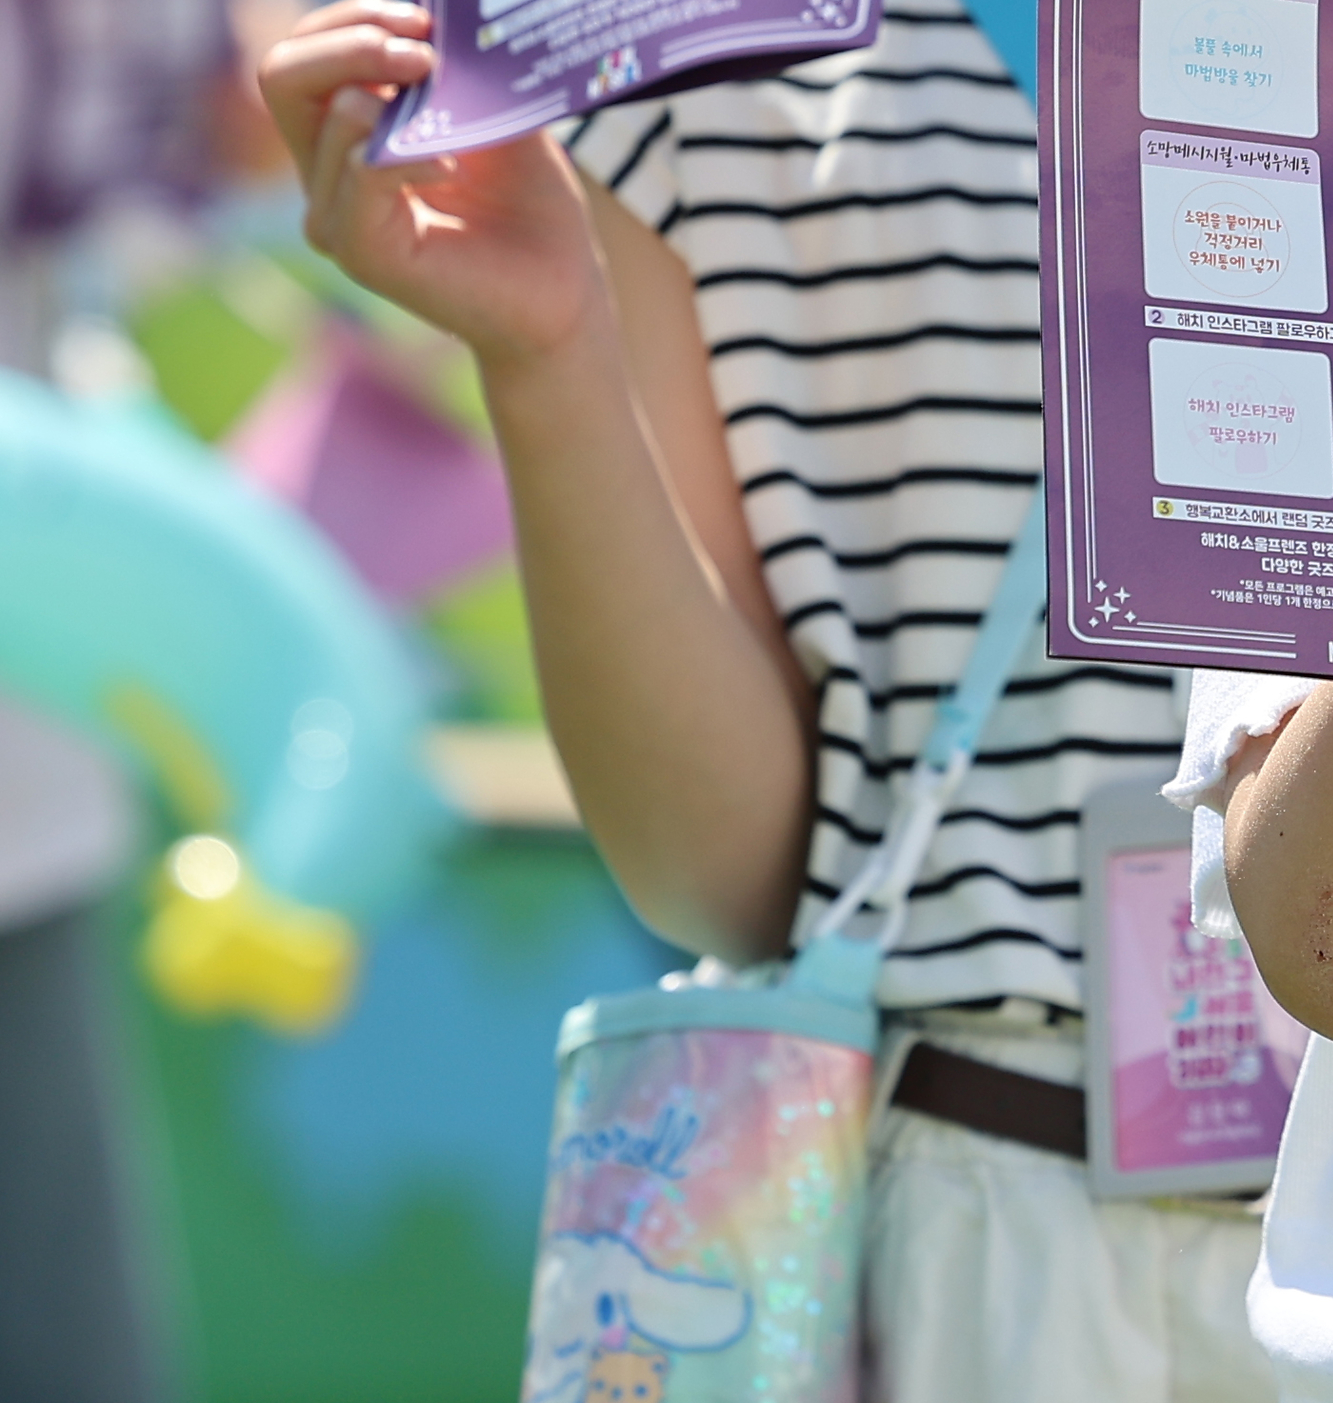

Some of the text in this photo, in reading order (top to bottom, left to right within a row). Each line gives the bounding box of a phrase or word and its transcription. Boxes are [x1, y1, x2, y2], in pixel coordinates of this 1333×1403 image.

[1221, 41, 1263, 59] 속에서
[1185, 63, 1272, 88] 마법방울 찾기
[1184, 210, 1282, 233] 소원을 붙이거나
[1204, 232, 1263, 251] 걱정거리
[1189, 251, 1280, 274] 우체통에 넣기
[1151, 310, 1162, 324] 2
[1177, 313, 1203, 328] 해치
[1207, 315, 1272, 334] 인스타그램
[1188, 398, 1295, 423] 해치 인스타그램
[1209, 426, 1277, 445] 팔로우하기
[1185, 503, 1278, 525] 행복교환소에서
[1282, 512, 1308, 528] 랜덤
[1201, 532, 1308, 555] 해치&소울프렌즈
[1261, 557, 1303, 576] 다양한
[1266, 581, 1314, 596] 프로그램은
[1285, 596, 1301, 608] 1개
